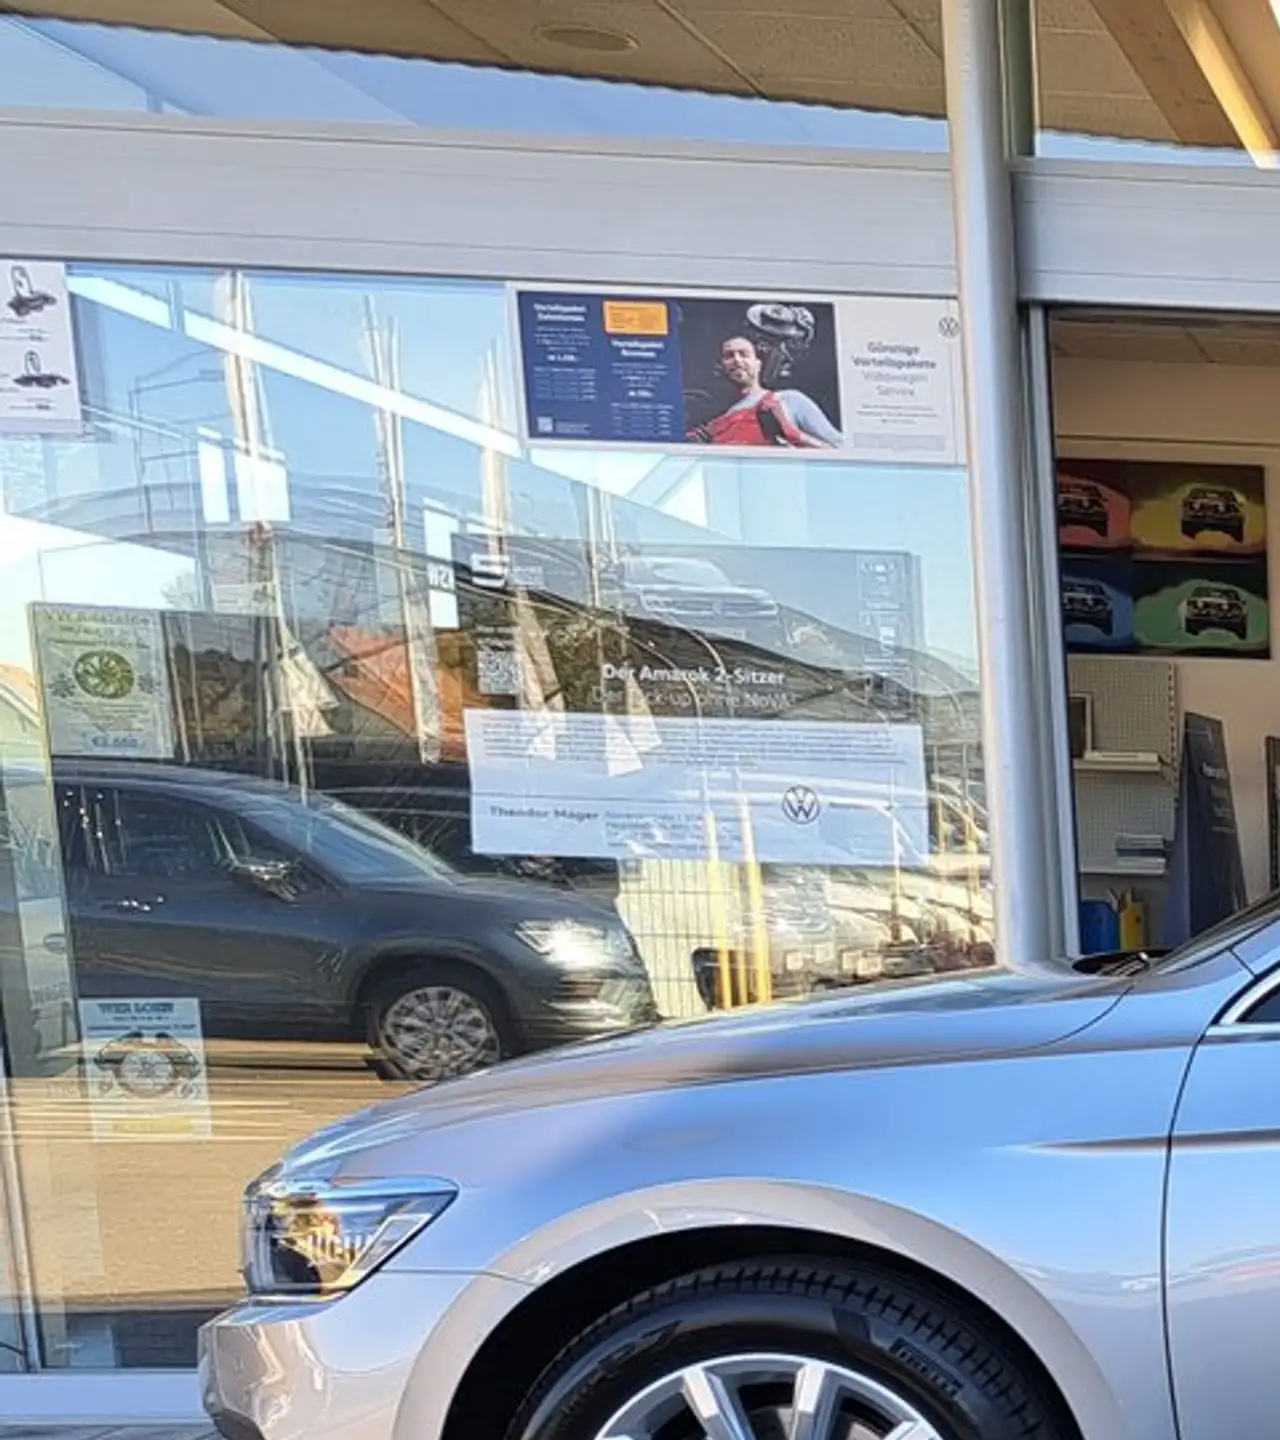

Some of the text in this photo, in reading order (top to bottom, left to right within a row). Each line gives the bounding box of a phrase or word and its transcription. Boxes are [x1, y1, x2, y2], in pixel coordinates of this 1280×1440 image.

[866, 341, 921, 356] Günstige
[852, 356, 937, 370] Vorteilspakete
[602, 663, 786, 686] Der Amarok 2-Sitzer
